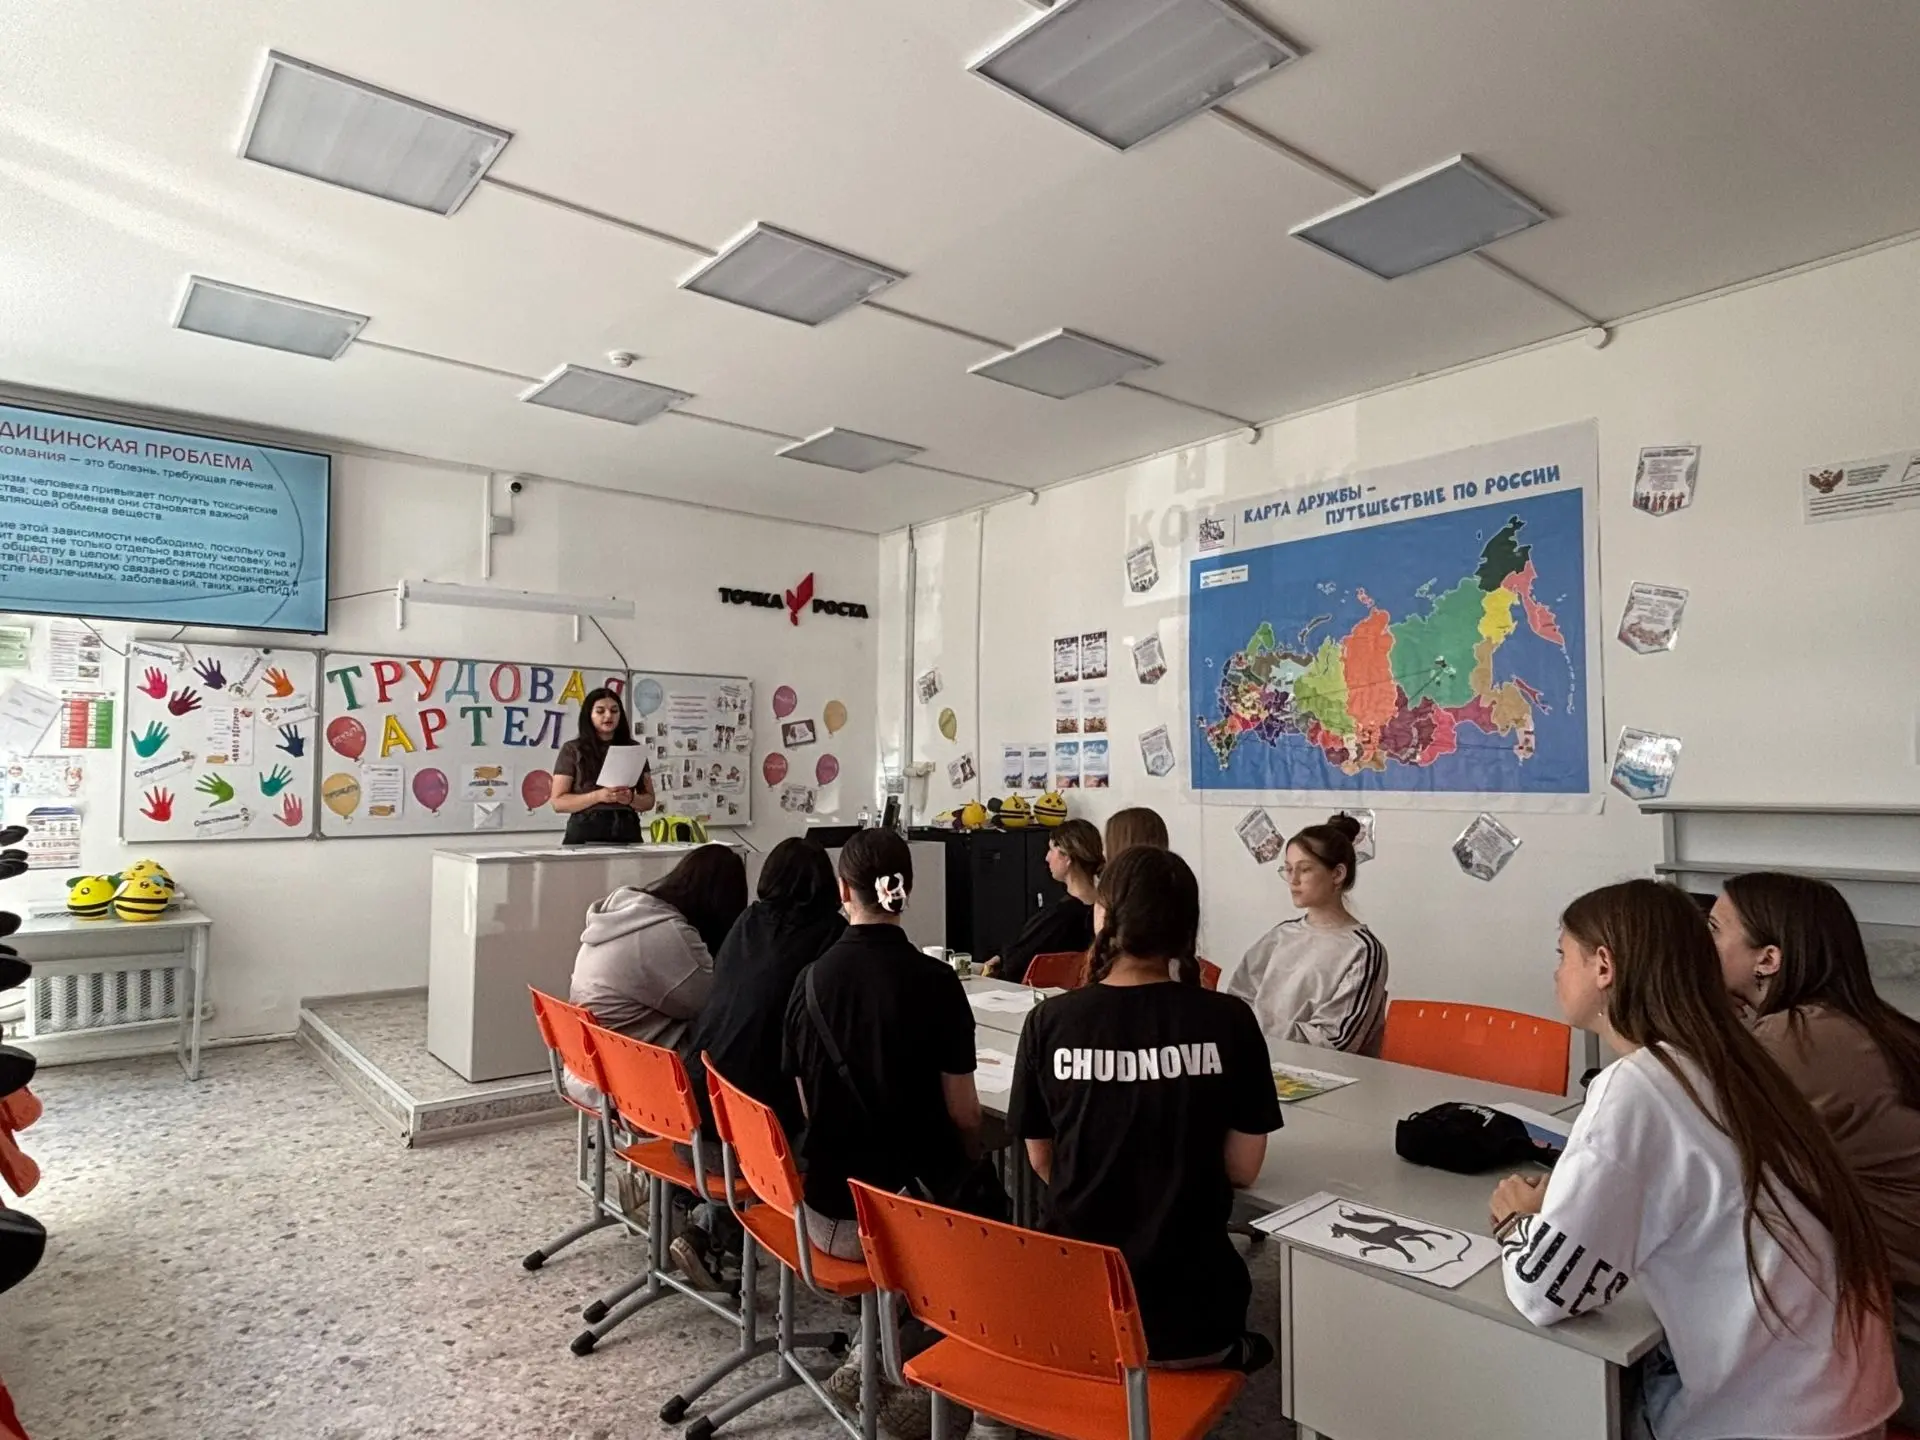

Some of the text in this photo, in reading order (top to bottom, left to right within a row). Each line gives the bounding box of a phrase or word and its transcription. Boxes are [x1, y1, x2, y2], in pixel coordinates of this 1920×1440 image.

[85, 458, 104, 468] это
[163, 467, 227, 486] требующая
[145, 442, 254, 472] ПРОБЛЕМА
[0, 472, 278, 516] изм человека привыкает получать токсические
[32, 487, 48, 497] со
[51, 490, 115, 505] временем
[117, 498, 140, 508] они
[142, 501, 206, 516] становятся
[209, 508, 249, 520] важной
[61, 501, 109, 514] обмена
[1243, 500, 1291, 524] КАРТА
[1296, 483, 1362, 515] ДРУЖБЫ
[1325, 464, 1561, 526] ПУТЕШЕСТВИЕ ПО РОССИИ
[16, 533, 48, 546] вред
[51, 537, 67, 546] не
[70, 538, 112, 550] только
[115, 543, 170, 556] отдельно
[172, 549, 218, 562] взятому
[274, 559, 287, 568] но
[290, 561, 297, 569] и
[20, 521, 49, 533] этой
[52, 526, 132, 542] зависимости
[210, 543, 265, 558] поскольку
[266, 549, 286, 558] она
[2, 541, 65, 558] обществу
[68, 548, 77, 557] в
[124, 553, 207, 571] употребление
[209, 562, 289, 577] психоактивных
[56, 558, 120, 573] напрямую
[122, 563, 170, 576] связано
[172, 568, 180, 577] с
[183, 569, 218, 582] рядом
[0, 563, 26, 574] сле
[238, 584, 256, 593] как
[258, 584, 290, 597] СПИД
[718, 586, 869, 619] ТОЧКА РОСТА
[1053, 1042, 1223, 1082] CHUDNOVA
